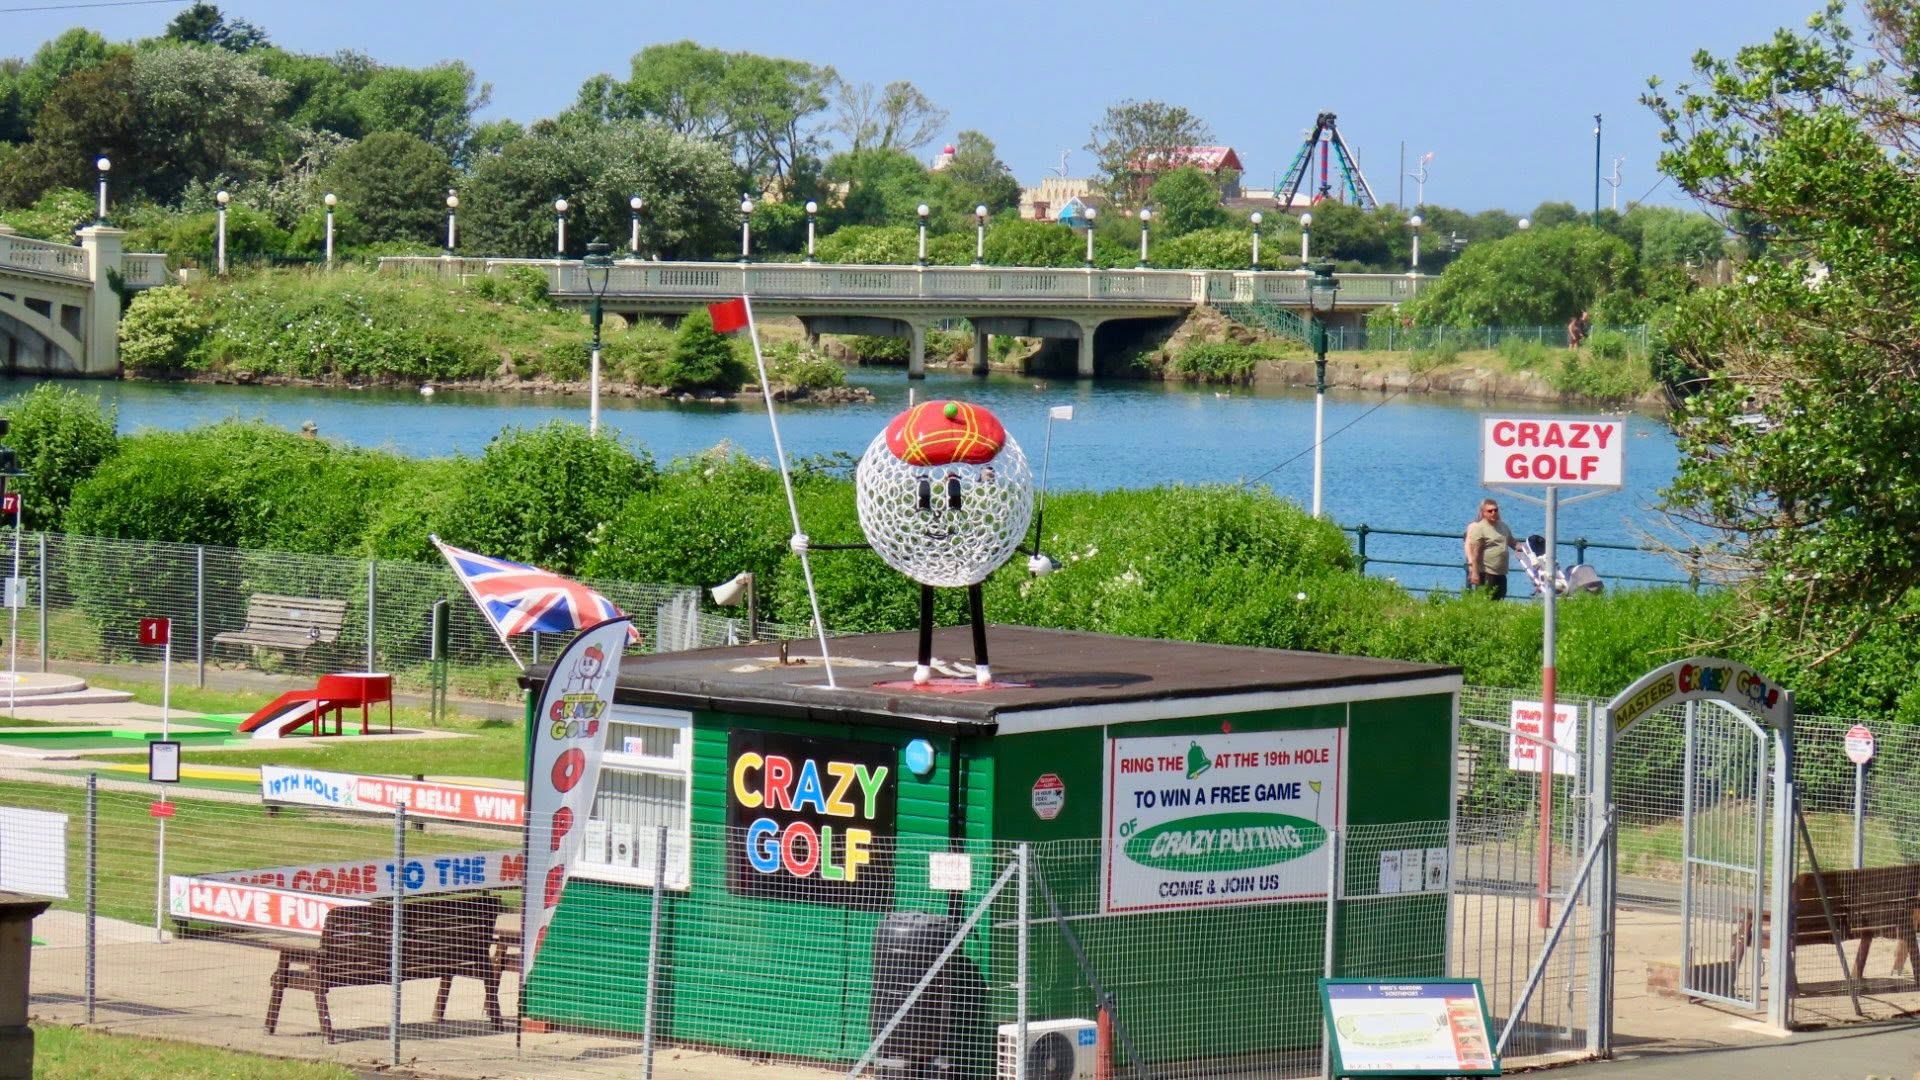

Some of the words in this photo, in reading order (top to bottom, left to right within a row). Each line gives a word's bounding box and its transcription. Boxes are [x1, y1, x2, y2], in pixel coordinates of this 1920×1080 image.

[1492, 421, 1613, 449] CRAZY
[1505, 453, 1599, 481] GOLF
[149, 623, 157, 639] 1
[1678, 663, 1733, 694] CRAZY
[550, 700, 607, 721] CRAZY
[1616, 678, 1674, 728] MASTERS
[551, 720, 599, 740] GOLF
[1120, 757, 1154, 774] RING
[1157, 756, 1184, 772] THE
[1214, 754, 1234, 769] AT
[1234, 752, 1259, 768] THE
[1263, 751, 1291, 767] 19th
[1294, 748, 1329, 764] HOLE
[269, 773, 299, 795] 19TH
[304, 773, 339, 803] HOLE
[732, 752, 888, 820] CRAZY
[1134, 790, 1156, 808] TO
[1160, 788, 1191, 807] WIN
[1195, 787, 1206, 805] A
[1211, 785, 1251, 804] FREE
[1254, 782, 1302, 801] GAME
[384, 784, 413, 807] THE
[415, 788, 461, 814] BELL!
[474, 794, 516, 821] WIN
[1119, 818, 1138, 838] OF
[1150, 828, 1219, 858] CRAZY
[1219, 825, 1303, 852] PUTTING
[746, 818, 872, 882] GOLF
[434, 856, 486, 887] THE
[1158, 879, 1203, 898] COME
[1206, 879, 1217, 895] &
[1221, 876, 1255, 894] JOIN
[1259, 874, 1279, 891] US
[191, 885, 271, 923] HAVE
